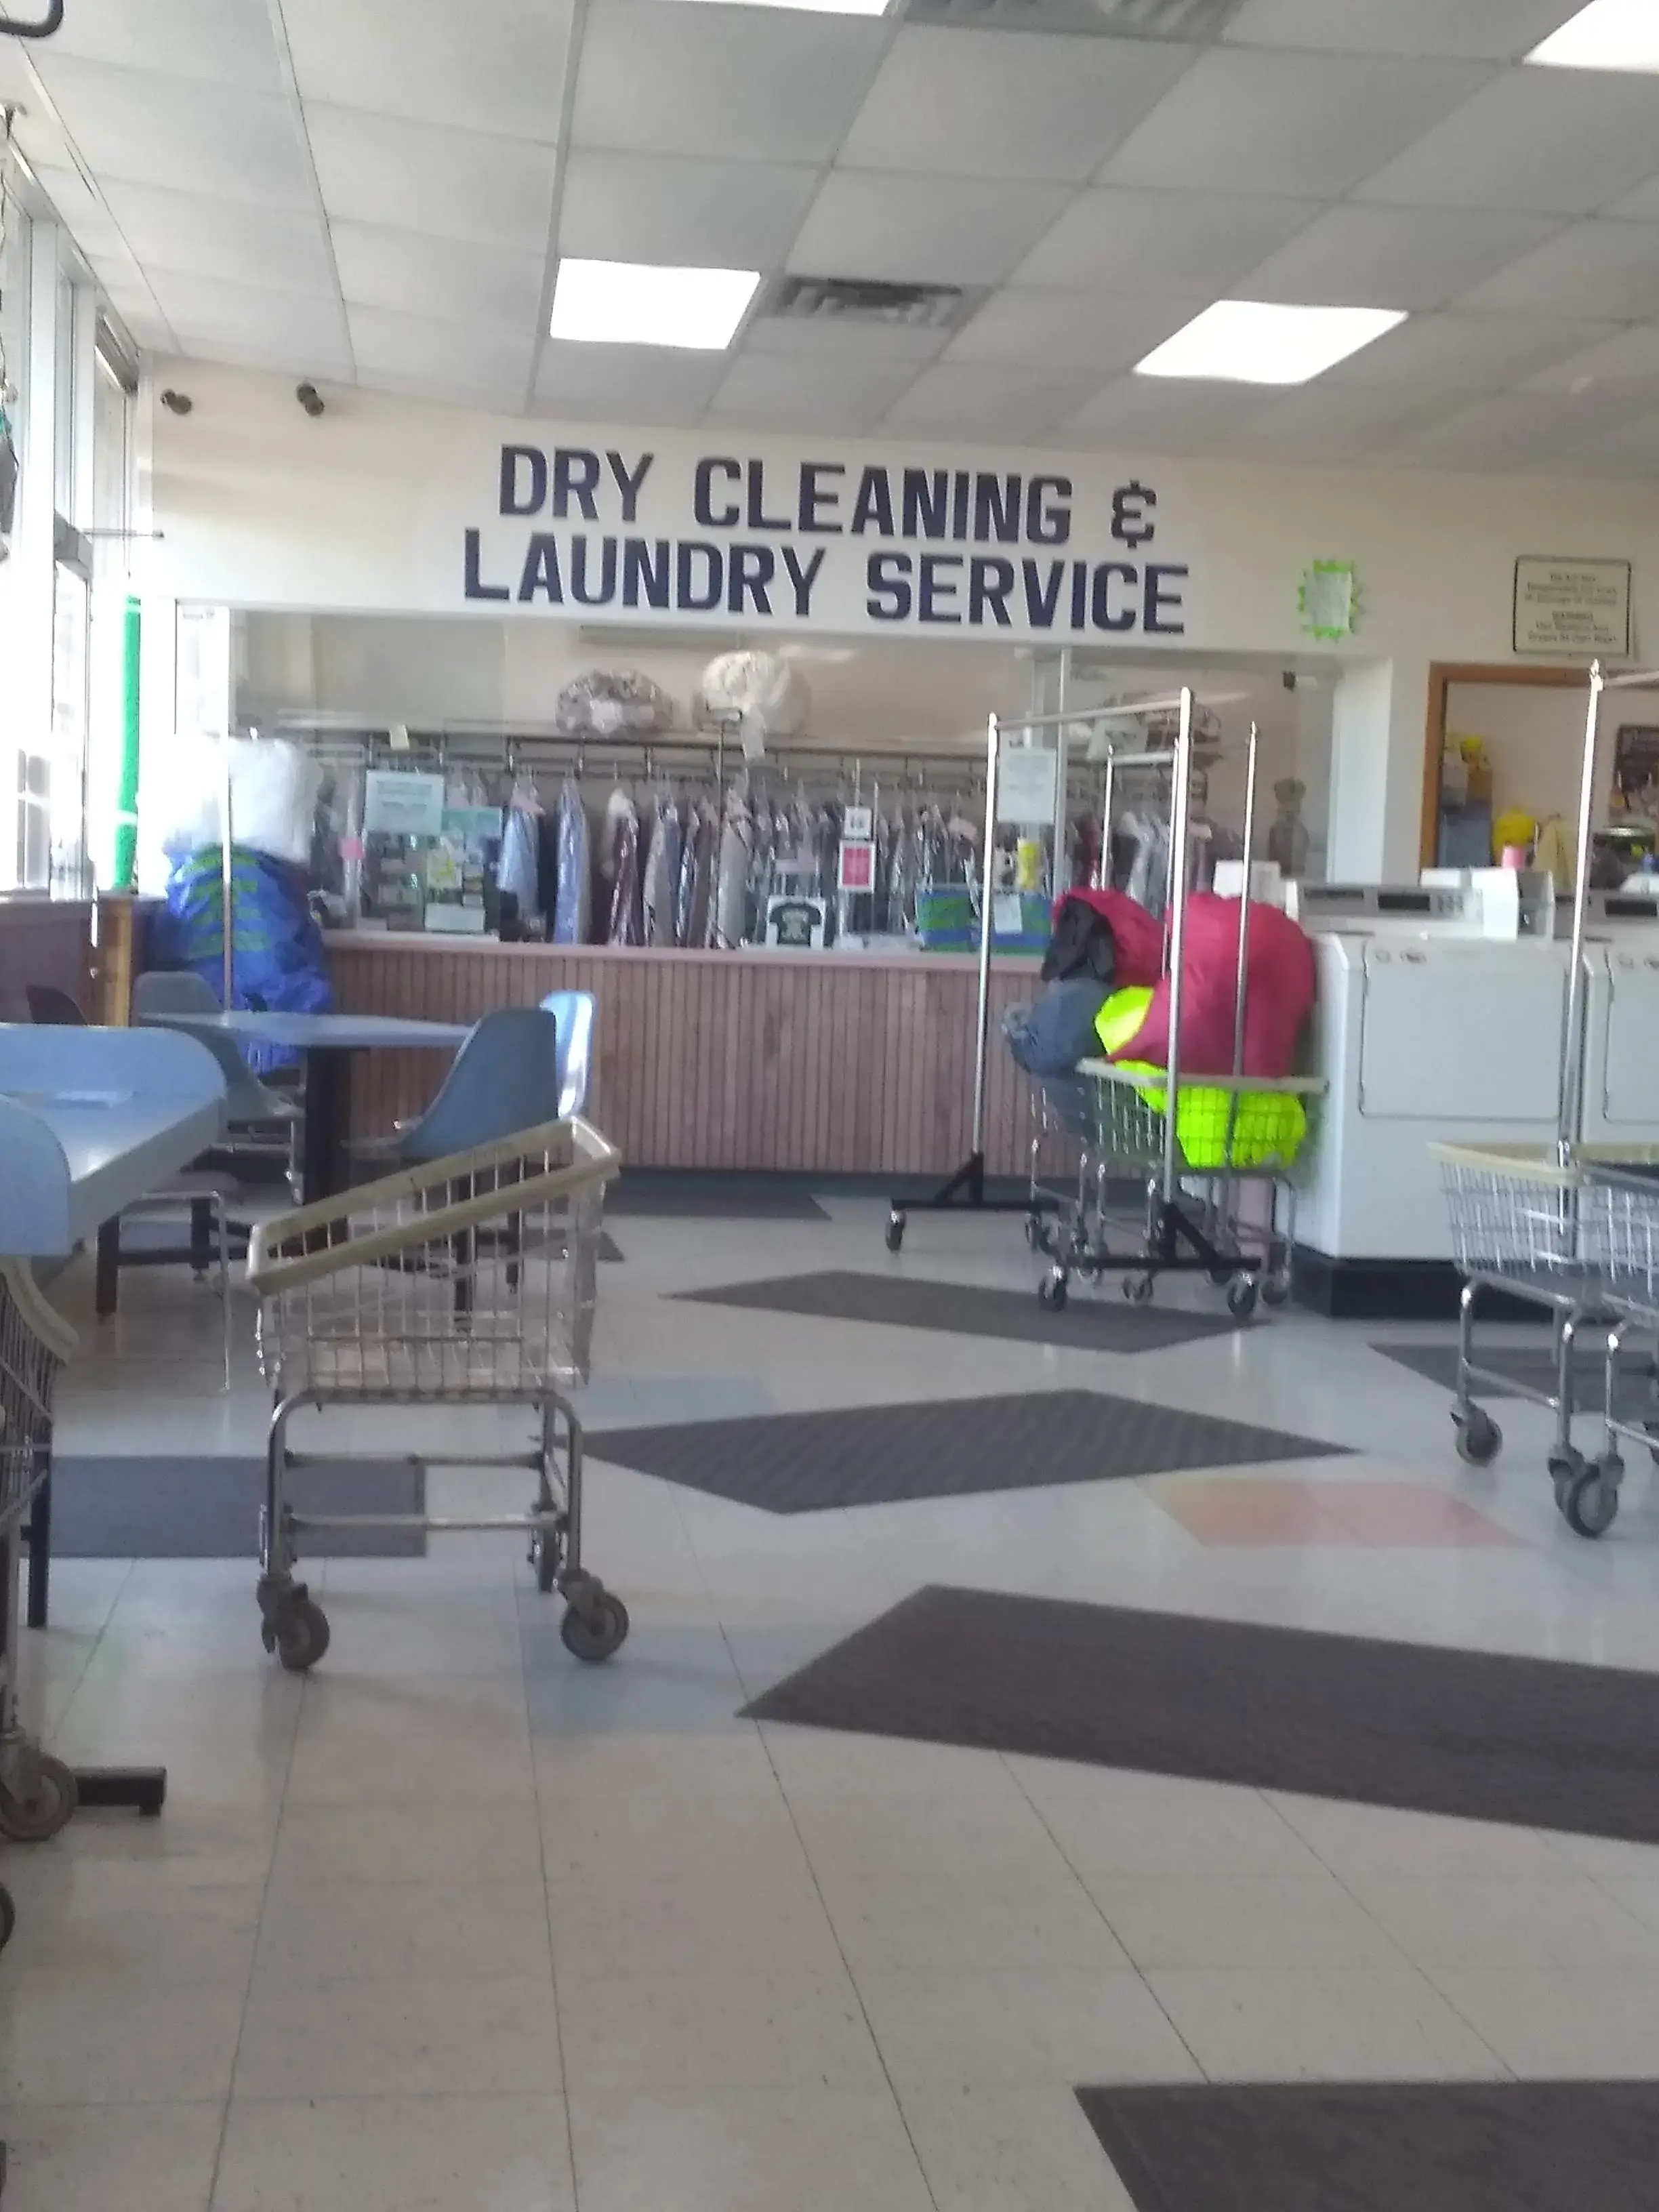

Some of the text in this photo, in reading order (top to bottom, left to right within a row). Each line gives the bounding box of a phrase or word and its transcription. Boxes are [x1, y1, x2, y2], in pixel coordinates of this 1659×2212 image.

[499, 445, 1157, 548] DRY CLEANING &
[464, 527, 1189, 634] LAUNDRY SERVICE
